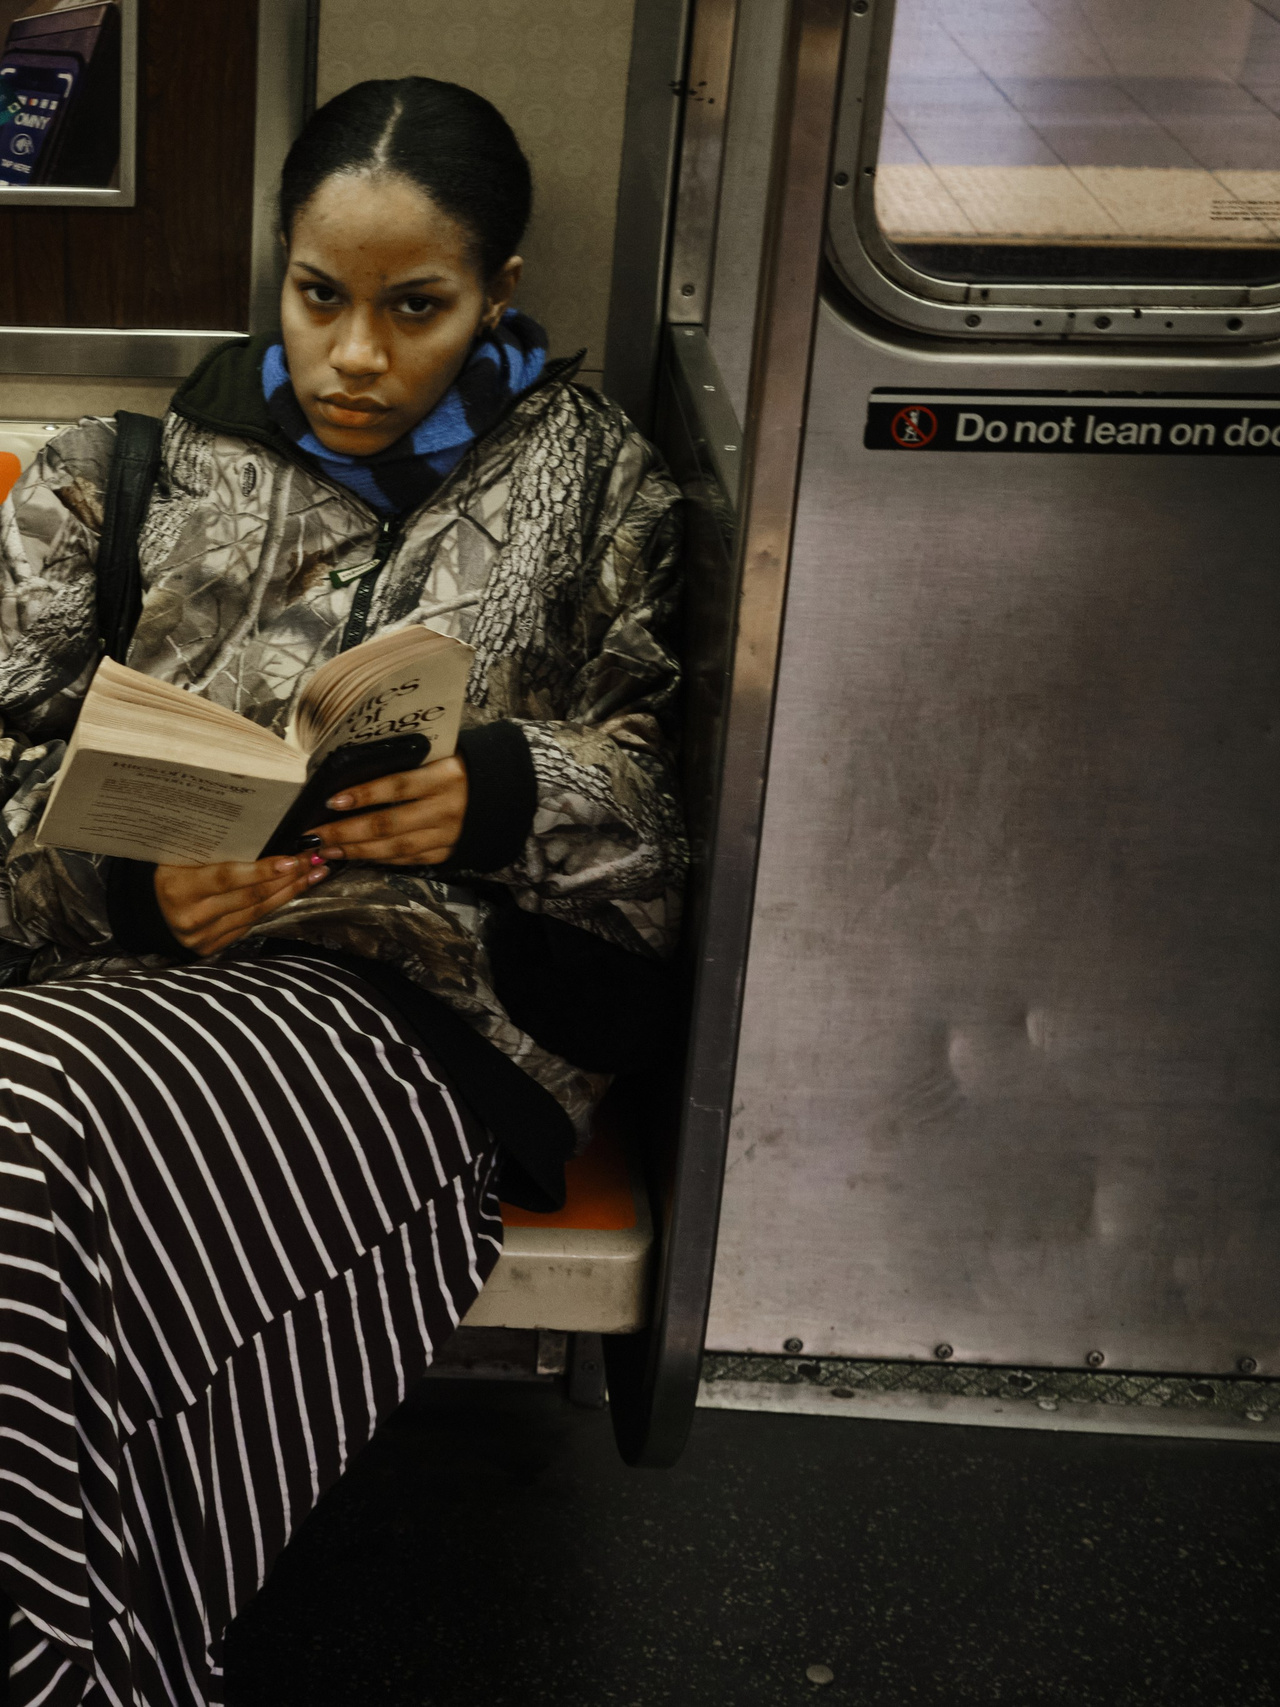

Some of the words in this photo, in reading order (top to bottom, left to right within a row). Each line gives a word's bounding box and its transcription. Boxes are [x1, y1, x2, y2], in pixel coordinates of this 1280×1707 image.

[955, 412, 1008, 443] Do
[1013, 416, 1076, 444] not
[1084, 415, 1162, 445] lean
[1169, 423, 1216, 446] on
